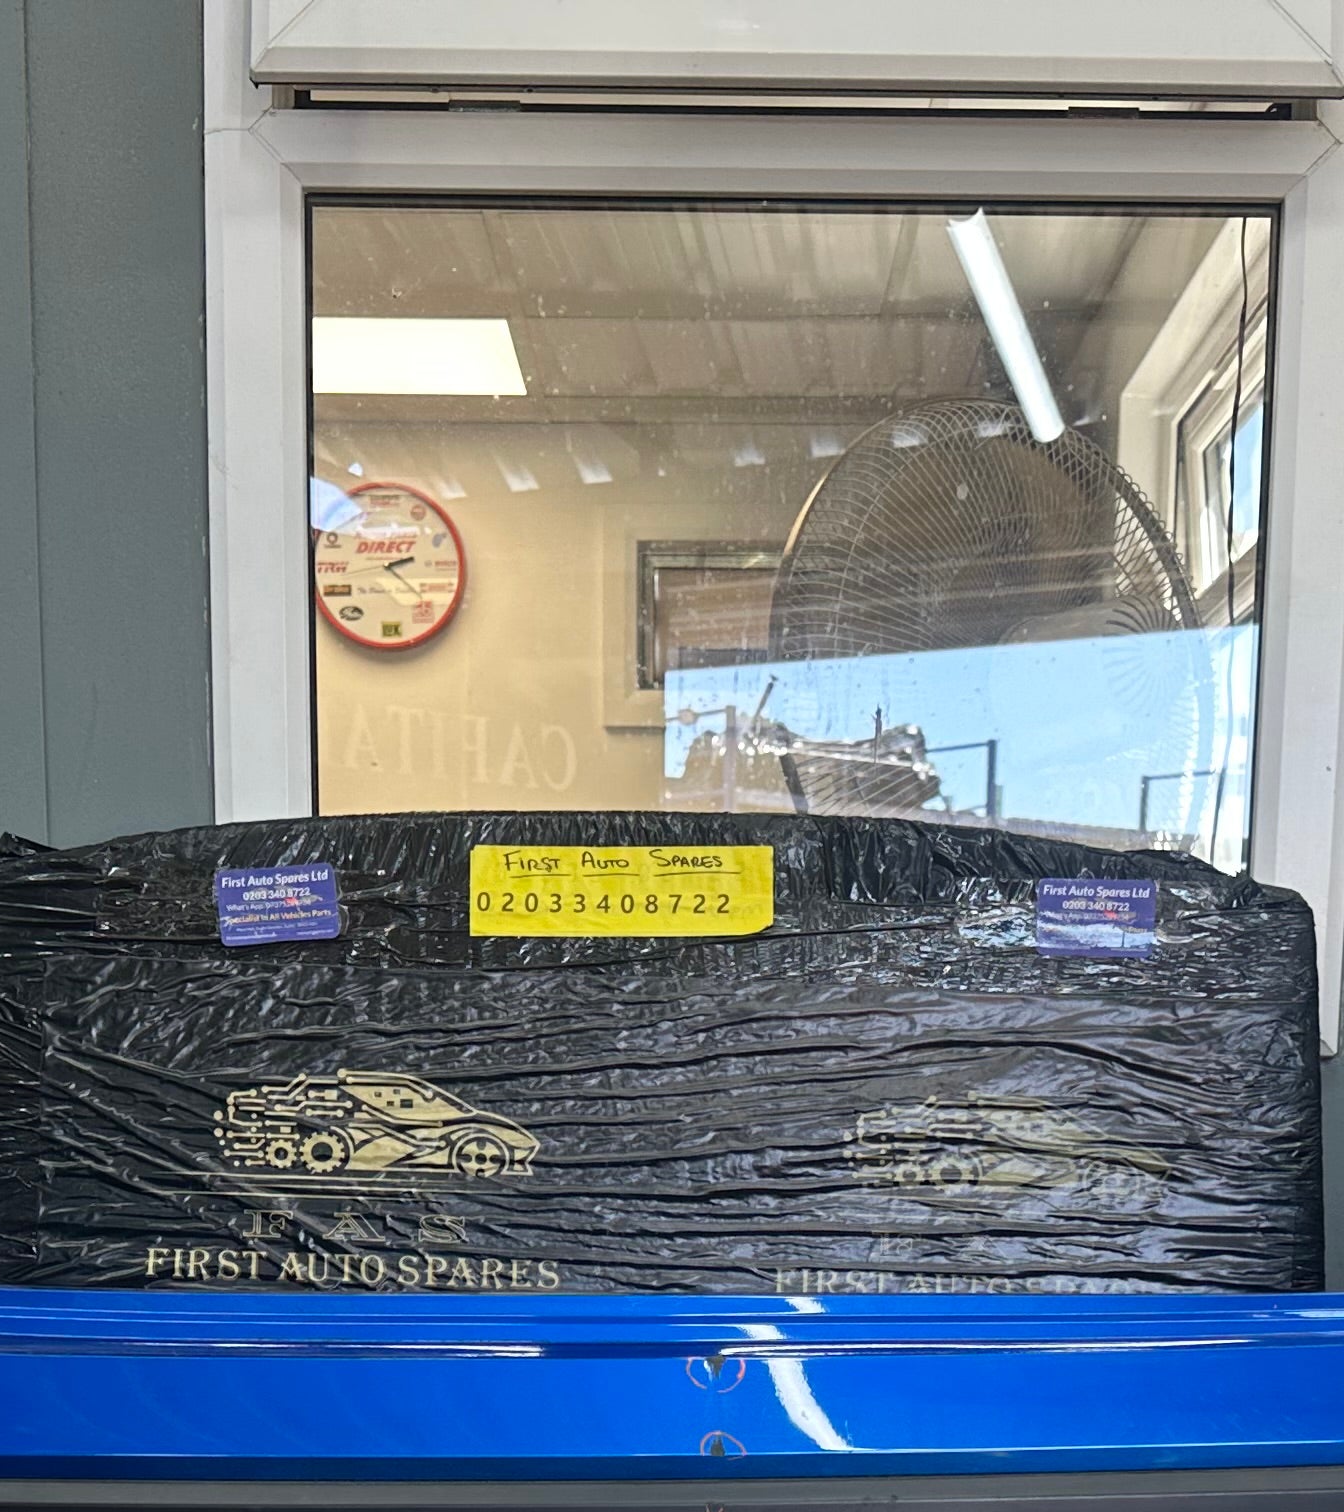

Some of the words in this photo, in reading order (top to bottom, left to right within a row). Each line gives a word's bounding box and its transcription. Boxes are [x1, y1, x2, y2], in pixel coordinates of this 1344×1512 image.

[356, 541, 416, 554] DIRECT
[221, 877, 245, 888] First
[247, 875, 273, 887] Auto
[275, 872, 309, 887] Spares
[311, 869, 329, 881] Ltd
[242, 891, 267, 901] 0203
[268, 889, 285, 899] 340
[287, 887, 311, 897] 8722
[1043, 884, 1067, 896] First
[1068, 886, 1094, 896] Auto
[1096, 886, 1130, 898] Spares
[1132, 888, 1150, 898] Ltd
[1062, 901, 1086, 910] 0203
[1087, 902, 1105, 911] 340
[1106, 902, 1130, 911] 8722
[145, 1247, 267, 1281] FIRST
[277, 1251, 385, 1283] AUTO
[398, 1254, 559, 1289] SPARES
[775, 1269, 895, 1294] FIRST
